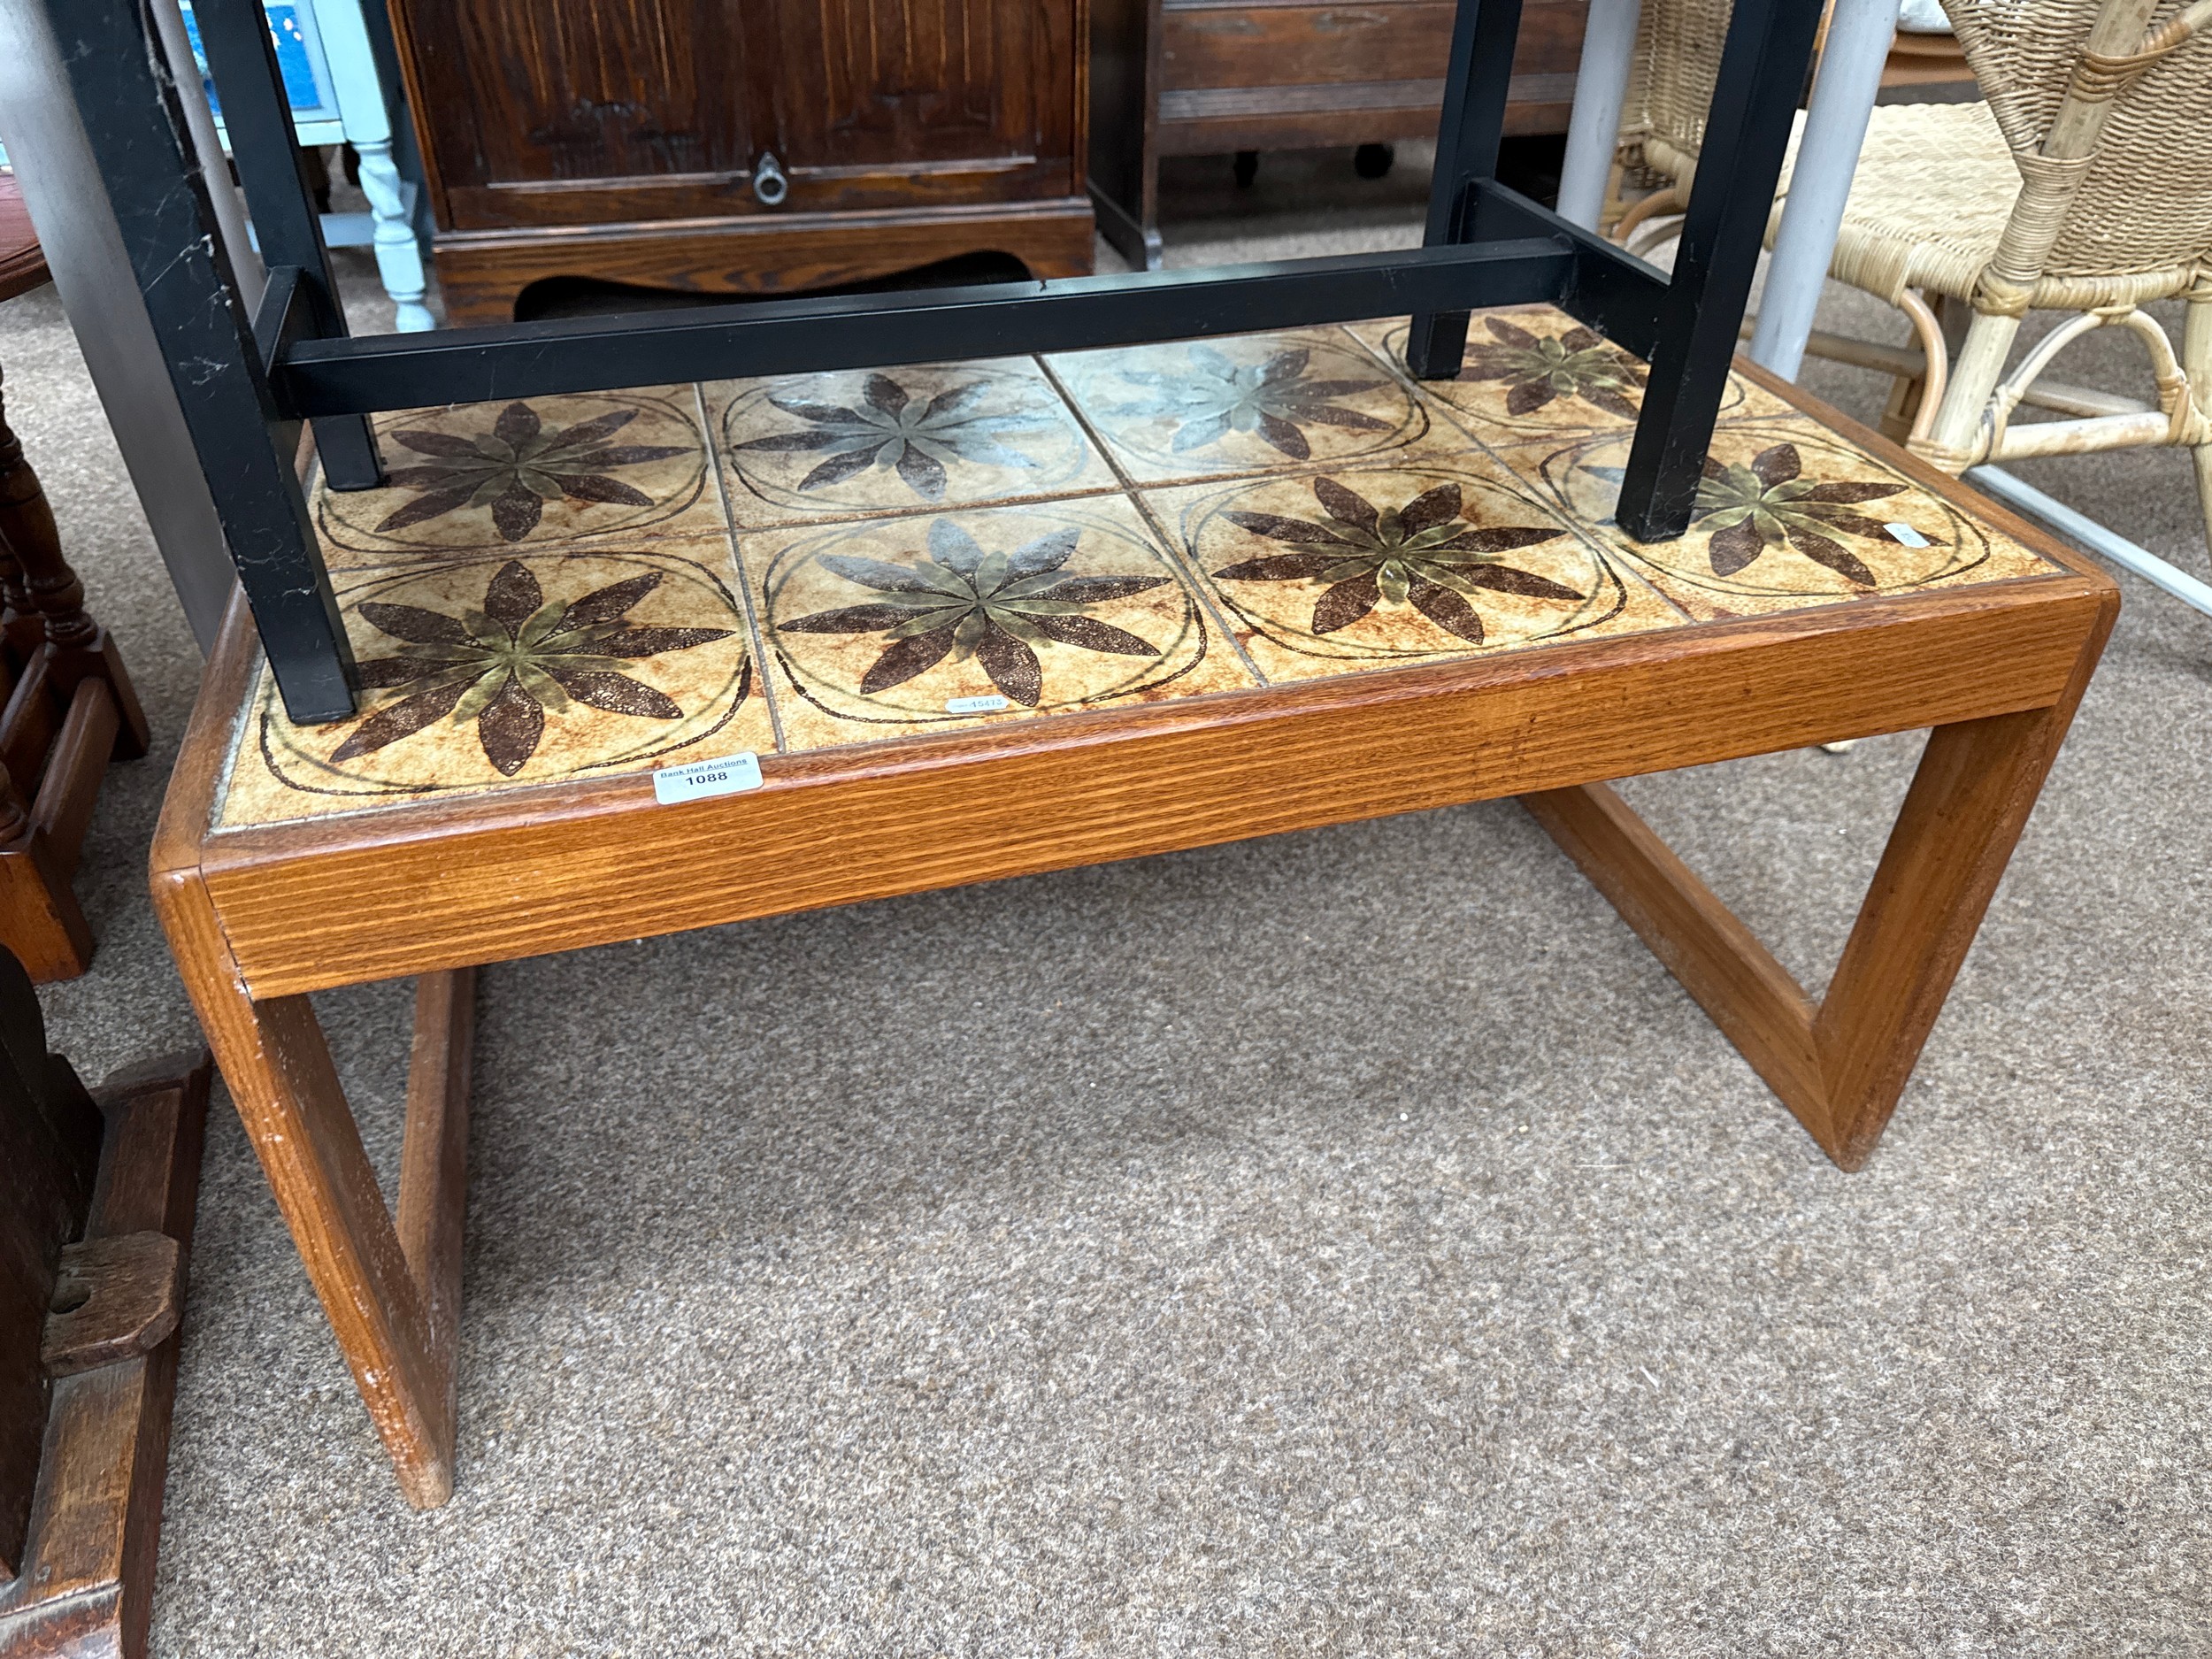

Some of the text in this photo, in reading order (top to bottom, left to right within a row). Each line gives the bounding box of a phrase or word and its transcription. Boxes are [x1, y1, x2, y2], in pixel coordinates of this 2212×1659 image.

[660, 758, 748, 779] Bank Hall Auctions
[686, 772, 728, 786] 1088
